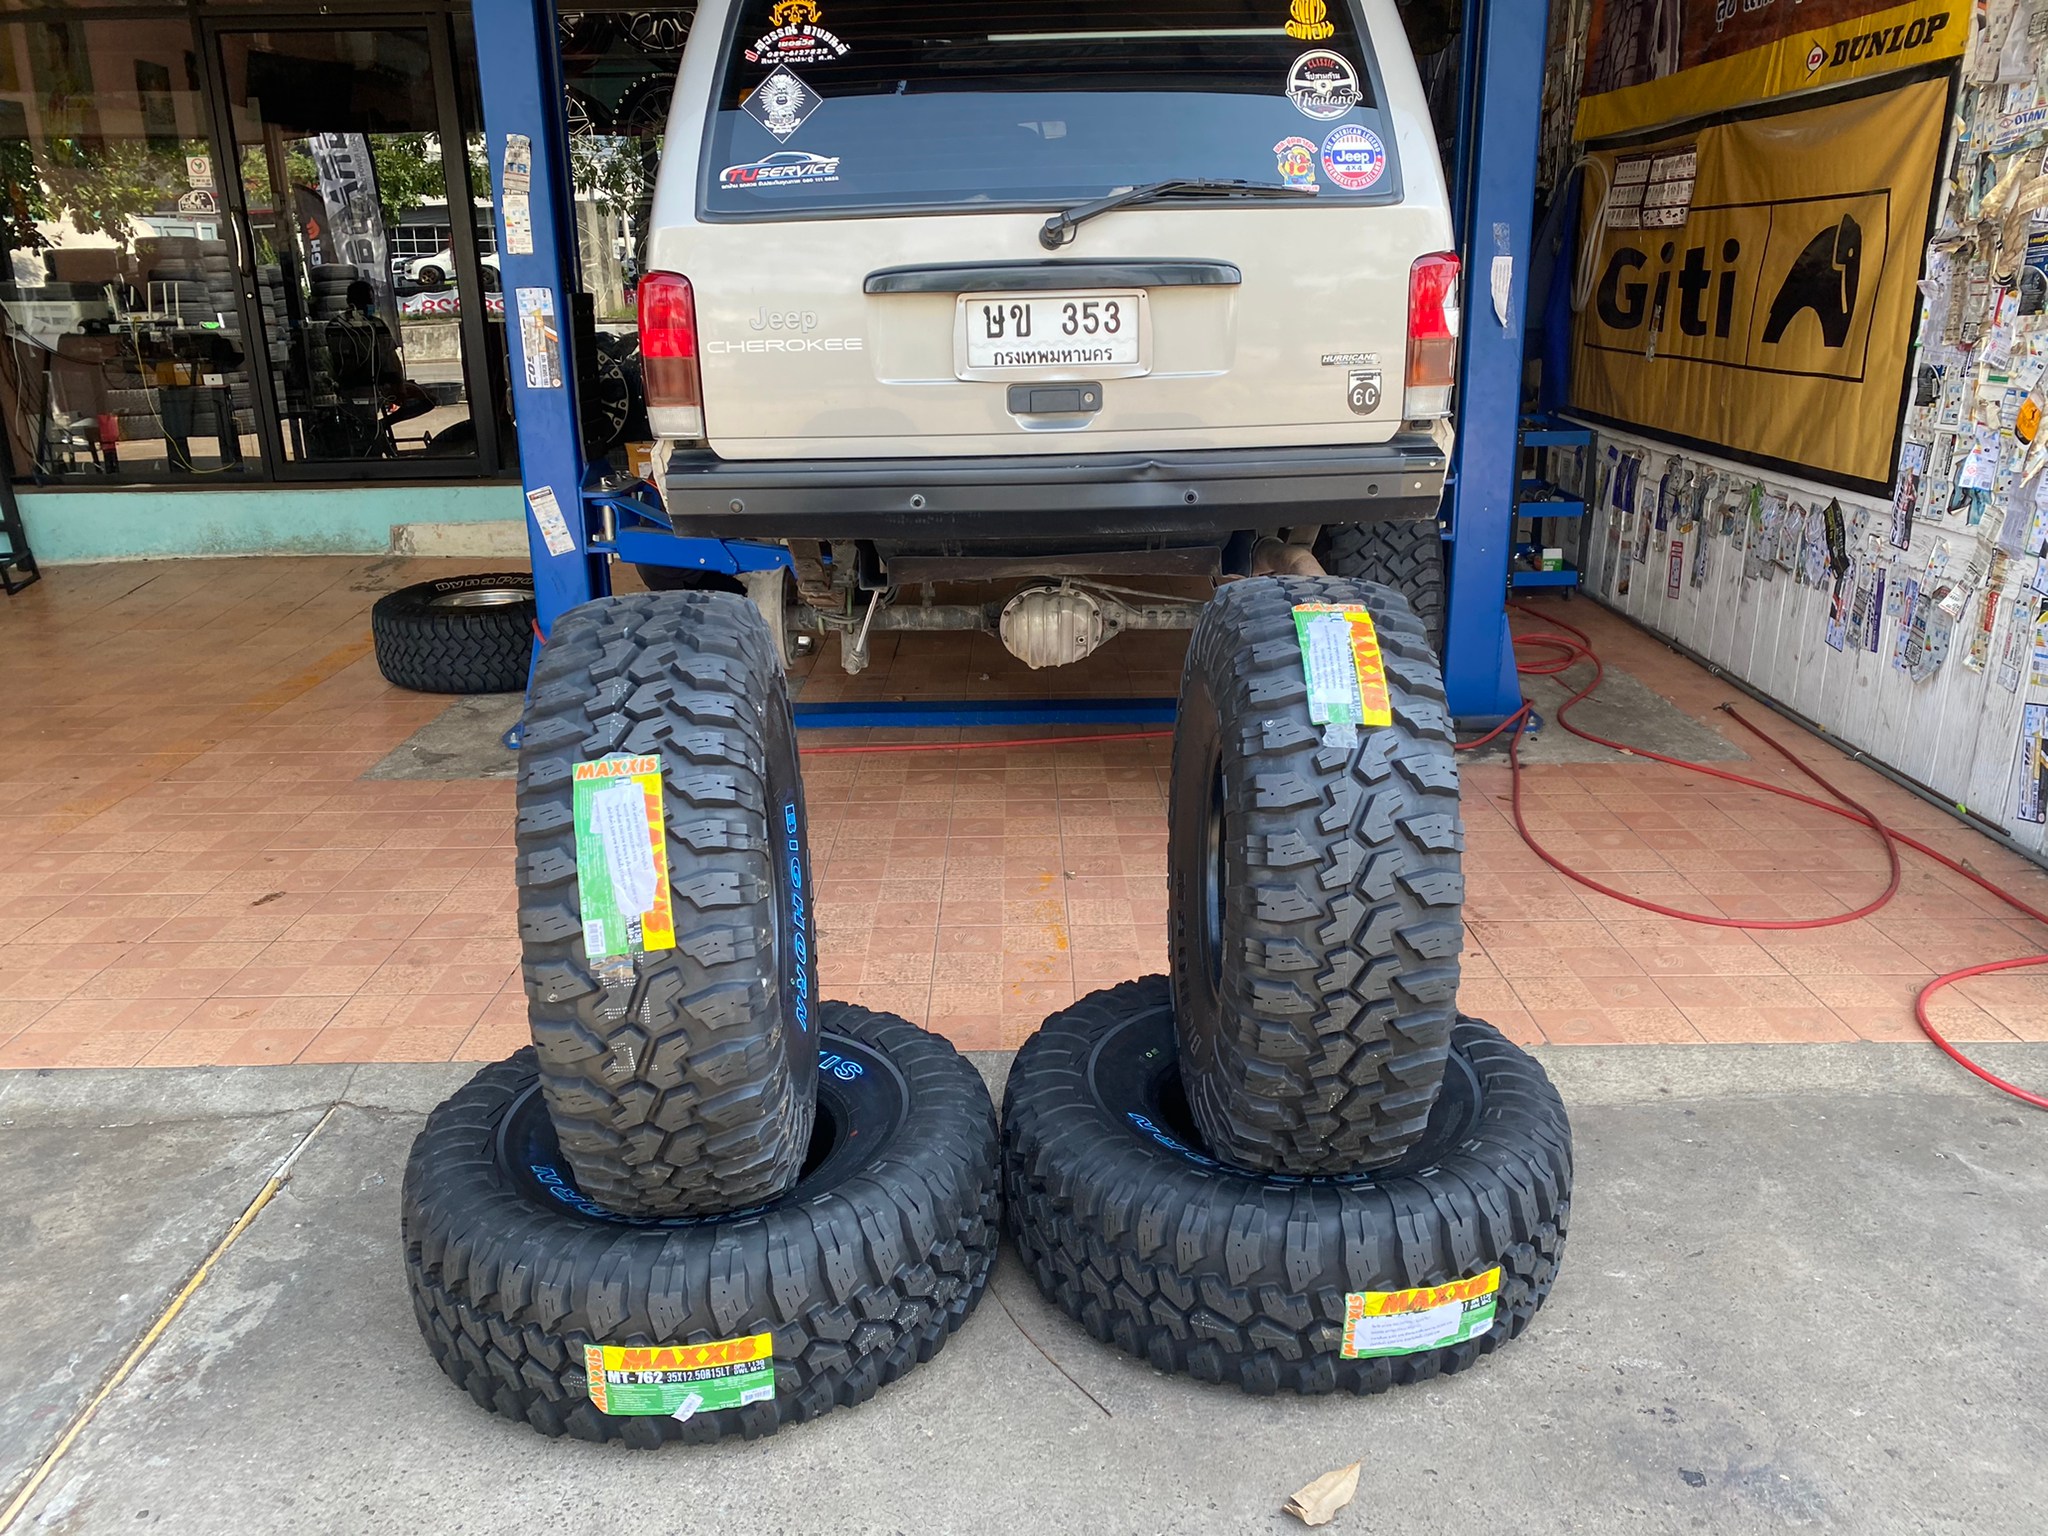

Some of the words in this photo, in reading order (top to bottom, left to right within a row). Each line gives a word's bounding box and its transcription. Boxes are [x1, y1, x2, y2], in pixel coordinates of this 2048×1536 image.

[1829, 12, 1950, 68] DUNLOP
[1307, 57, 1336, 69] CLASSIC
[1290, 89, 1359, 109] Thailand
[2015, 109, 2047, 126] OTANI
[1325, 138, 1333, 153] THE
[1331, 127, 1362, 141] AMERICAN
[1362, 131, 1381, 153] LEGEND
[1336, 150, 1370, 165] Jeep
[1598, 238, 1741, 339] Giti
[750, 306, 818, 333] Jeep
[1062, 301, 1121, 336] 353
[707, 338, 863, 354] CHEROKEE
[1351, 621, 1389, 714] MAXXIS
[576, 757, 658, 781] MAXXIS
[784, 803, 807, 1033] BIGHORN
[1380, 1274, 1490, 1313] MAXXIS
[1343, 1294, 1366, 1358] MAXXIS
[621, 1337, 757, 1370] MAXXIS
[587, 1347, 608, 1413] MAXXIS
[607, 1369, 664, 1384] MT-762
[666, 1366, 730, 1383] 35X12.50R15LT
